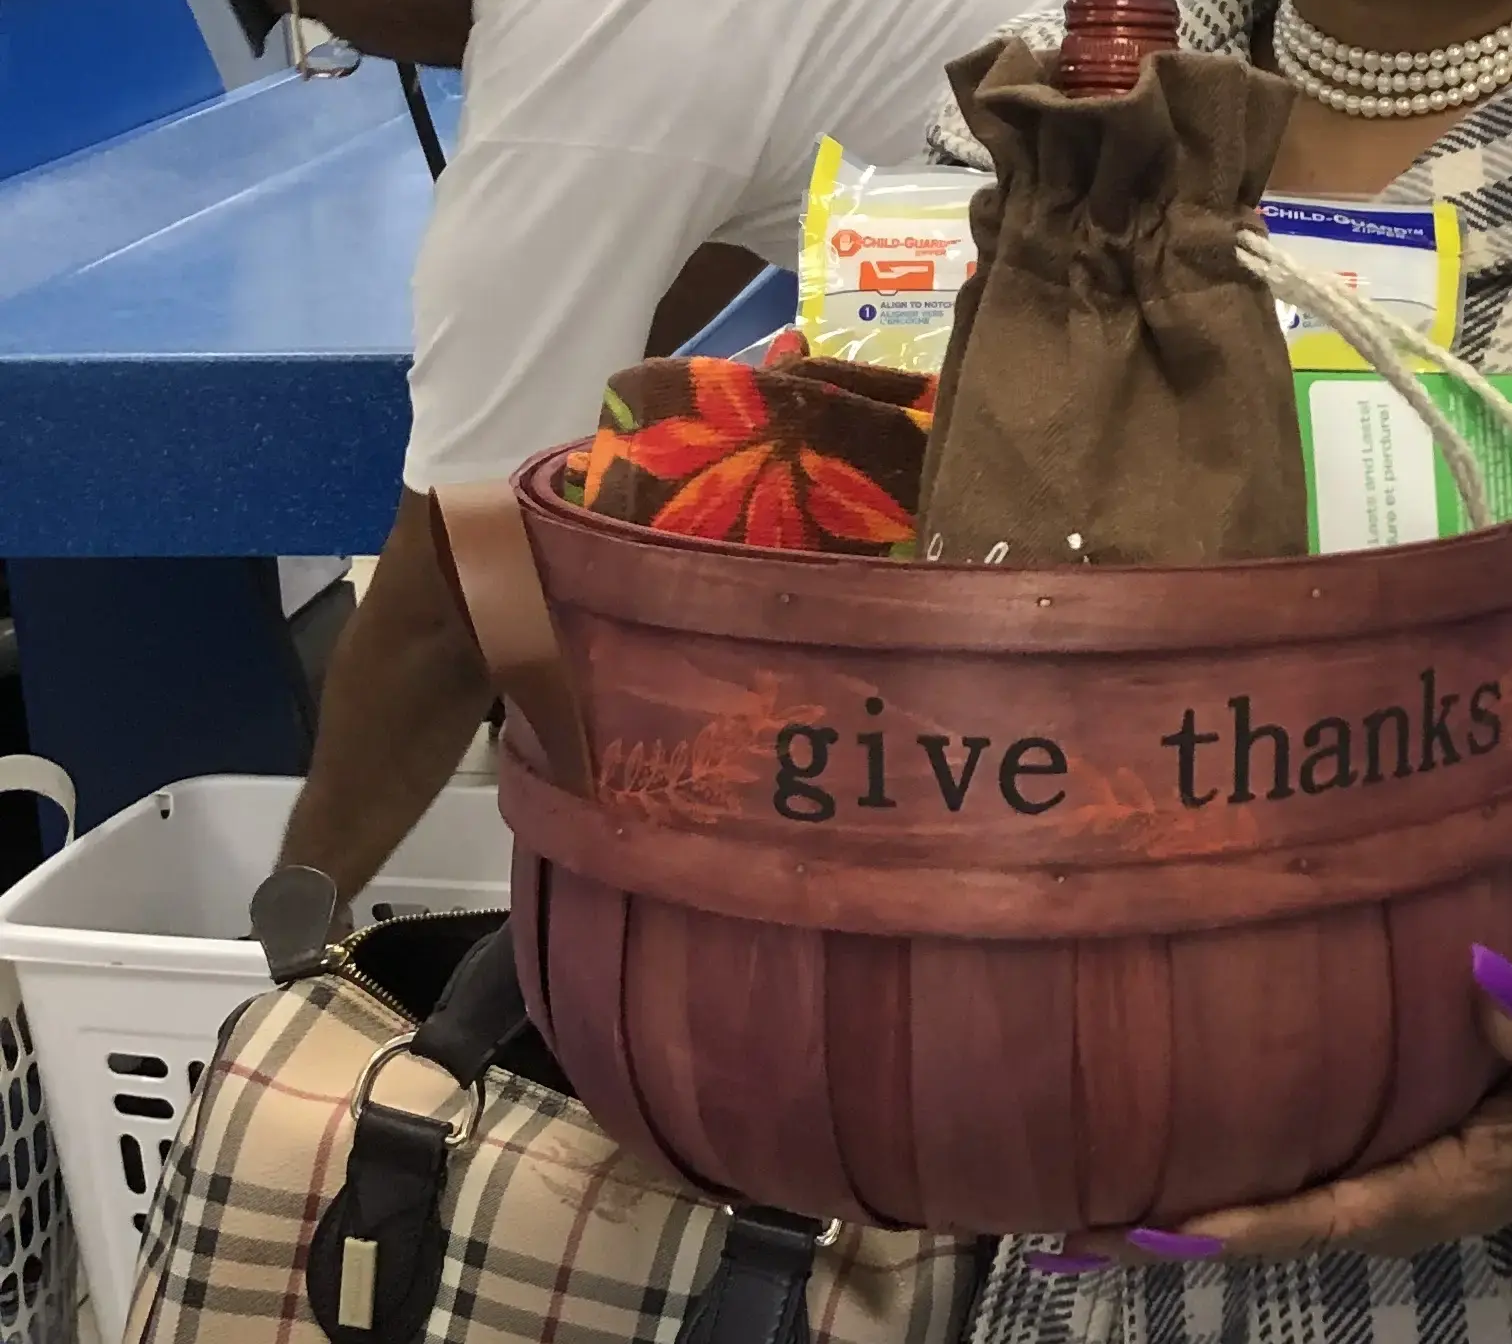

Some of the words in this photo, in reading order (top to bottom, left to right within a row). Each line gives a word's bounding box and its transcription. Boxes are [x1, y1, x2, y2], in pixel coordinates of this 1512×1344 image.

[880, 301, 908, 309] ALIGN
[910, 301, 922, 309] TO
[1361, 458, 1376, 492] and
[1384, 487, 1396, 506] et
[774, 697, 1067, 822] give
[1161, 665, 1504, 809] thanks
